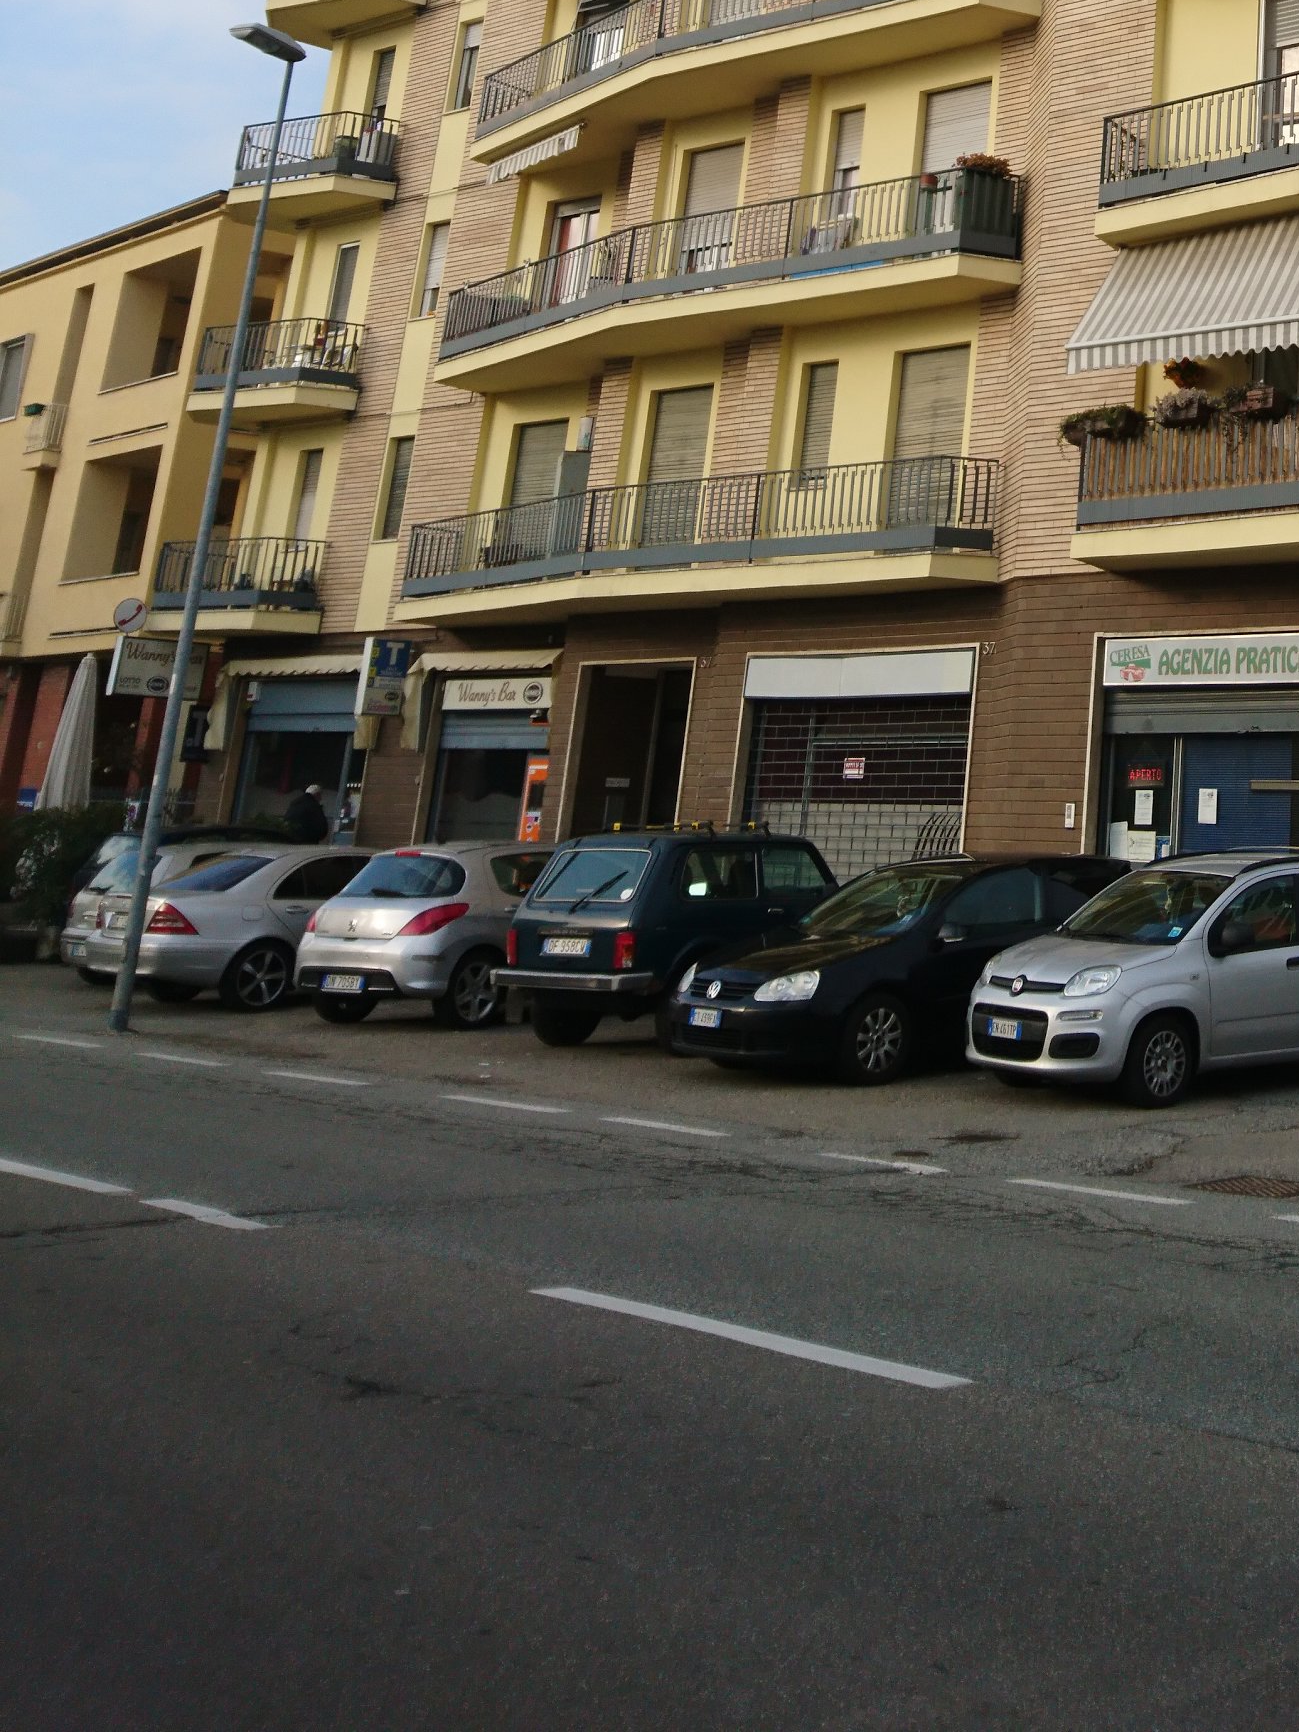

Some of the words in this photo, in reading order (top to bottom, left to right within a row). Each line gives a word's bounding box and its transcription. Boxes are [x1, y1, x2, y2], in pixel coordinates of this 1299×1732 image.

[386, 642, 405, 666] T
[1109, 644, 1152, 665] CERESA
[1158, 647, 1231, 676] AGENZIA
[458, 682, 497, 707] Wanny's
[498, 681, 517, 702] Bar
[1129, 768, 1162, 781] APERTO
